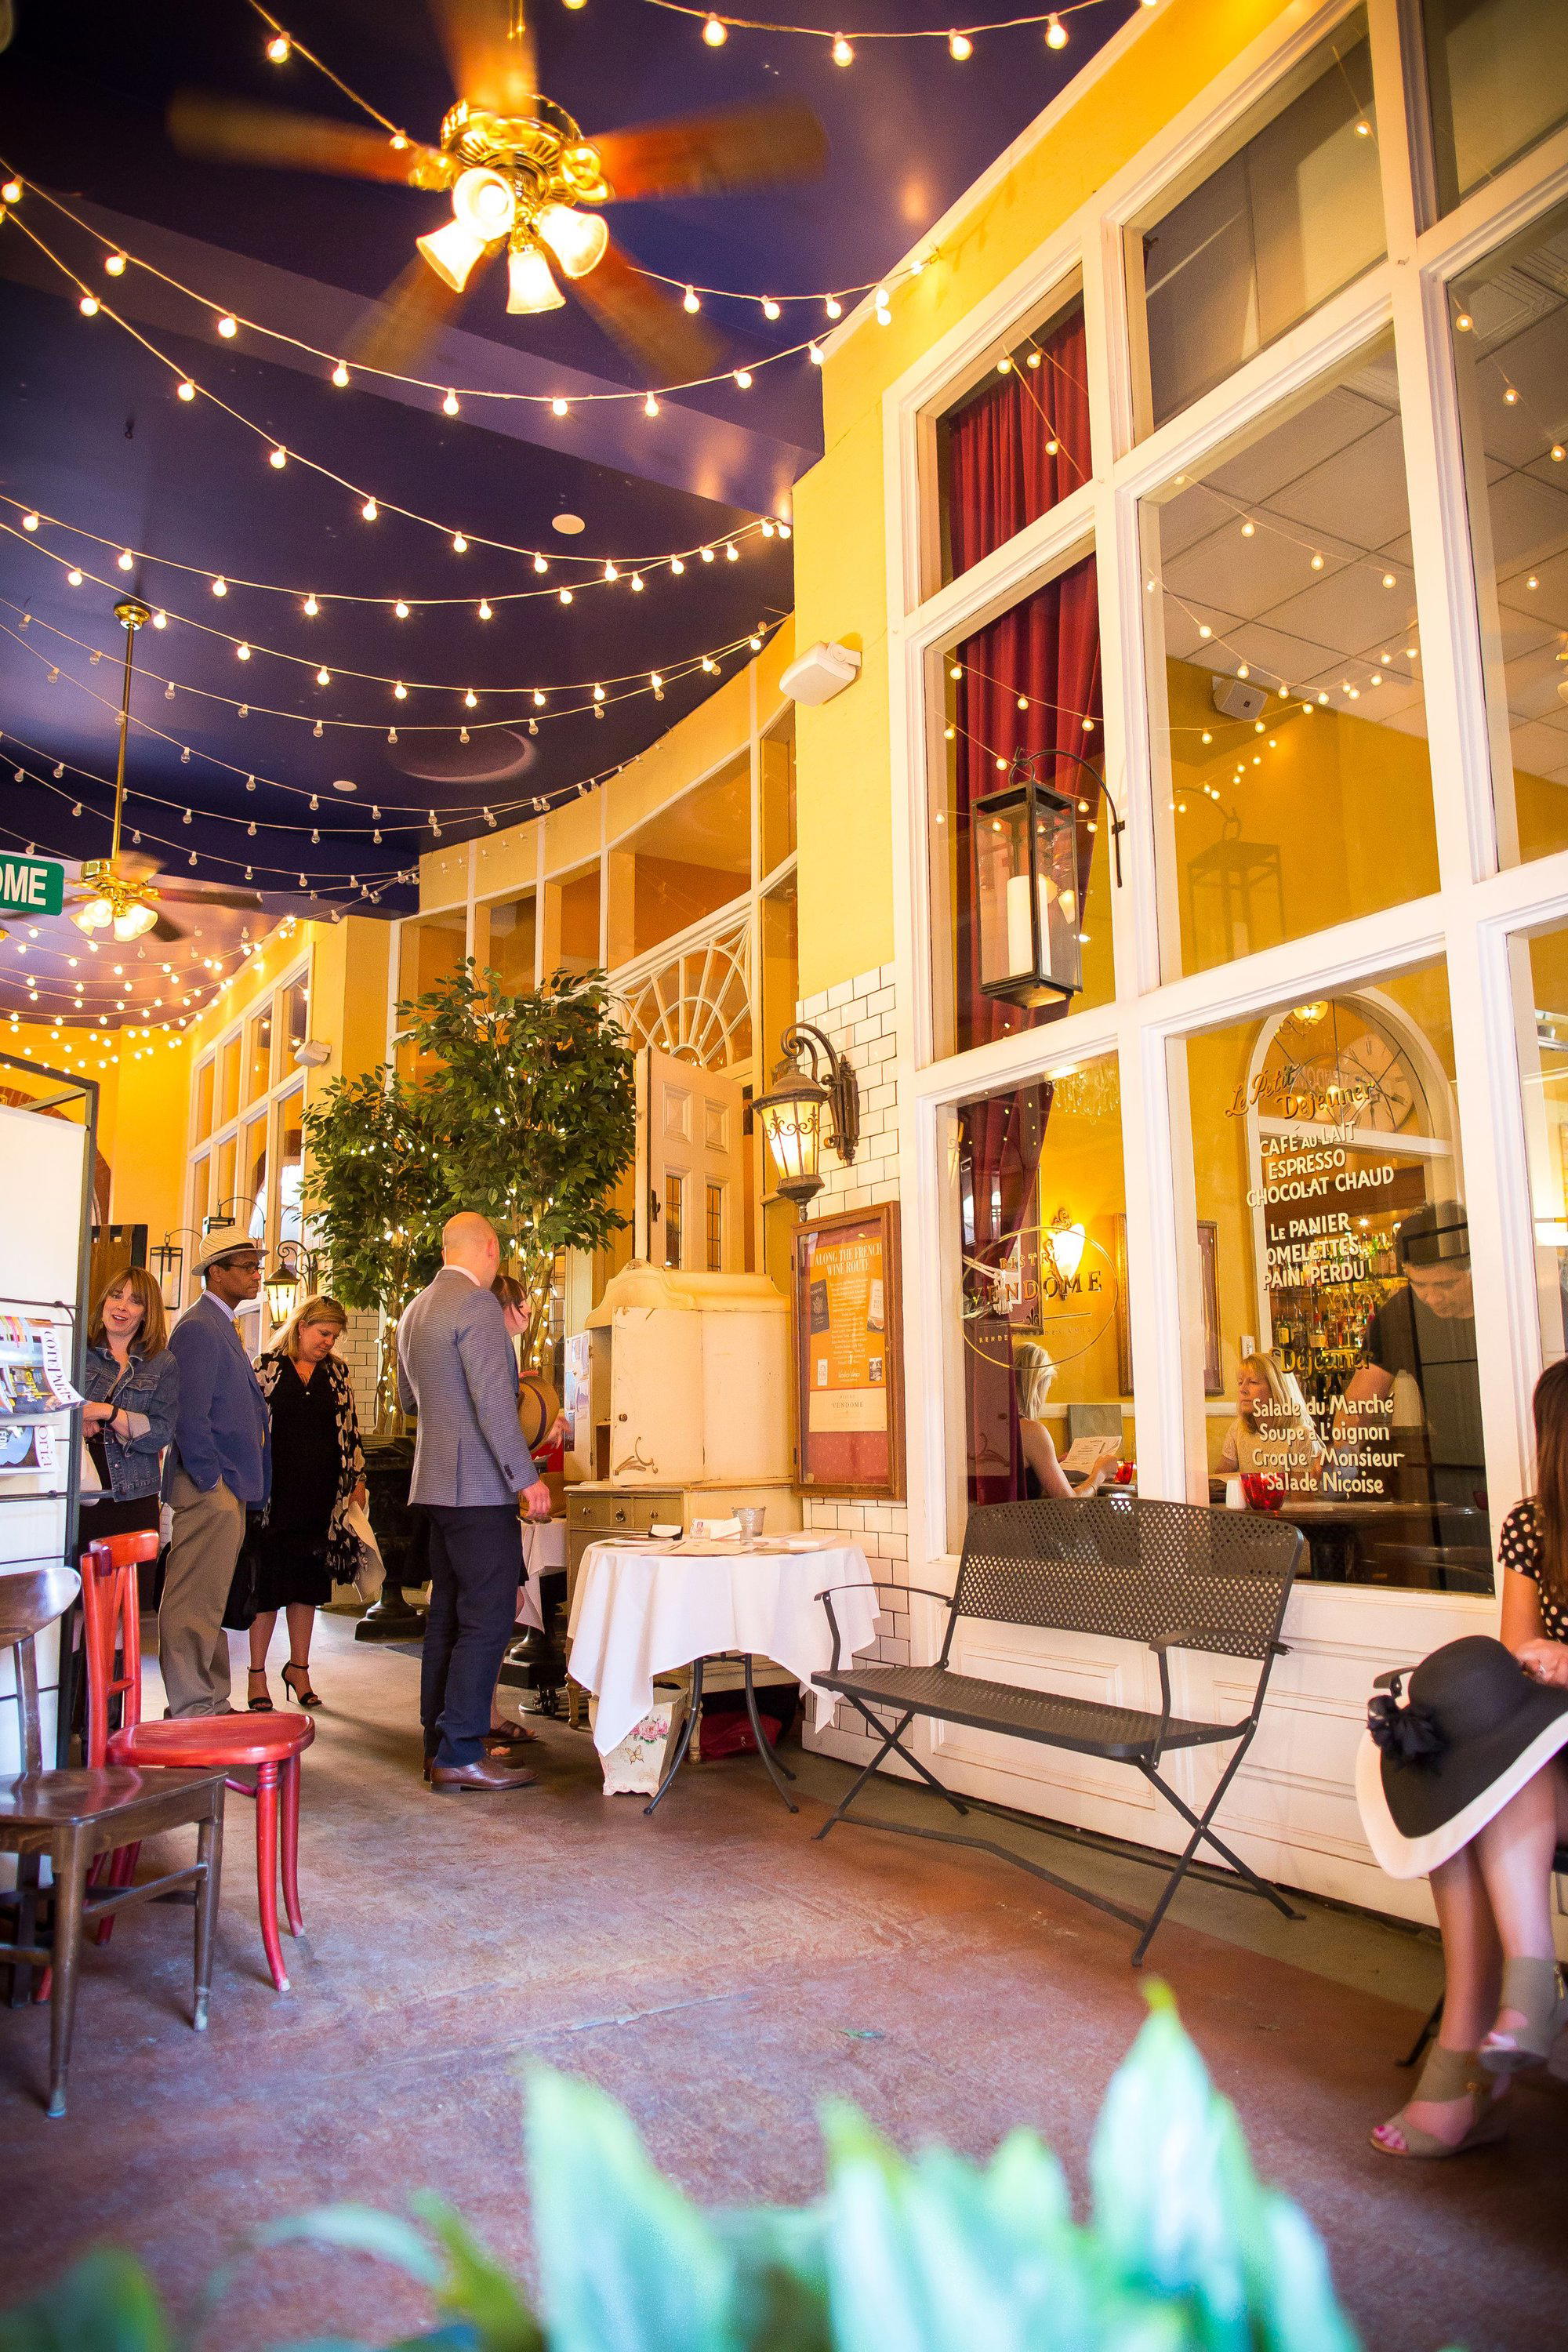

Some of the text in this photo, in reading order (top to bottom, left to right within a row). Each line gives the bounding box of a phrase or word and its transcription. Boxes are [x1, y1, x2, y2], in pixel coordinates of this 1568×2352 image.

[0, 863, 48, 906] ME
[1225, 1062, 1301, 1117] Le Petit
[1259, 1120, 1357, 1158] CAFÉ AU LAIT
[1268, 1148, 1346, 1181] ESPRESSO
[1246, 1166, 1395, 1207] CHOCOLAT CHAUD
[1289, 1212, 1352, 1238] PANIER
[815, 1242, 882, 1266] ALONG THE FRENCH
[1265, 1236, 1360, 1266] OMELETTES
[826, 1258, 870, 1276] WINE ROUTE
[1263, 1261, 1365, 1290] PAIN PERDU
[1252, 1392, 1395, 1417] Salade du Marché
[1259, 1423, 1305, 1446] Soupe
[1320, 1421, 1390, 1445] L'oignon
[1266, 1471, 1385, 1500] Salade Niçoise
